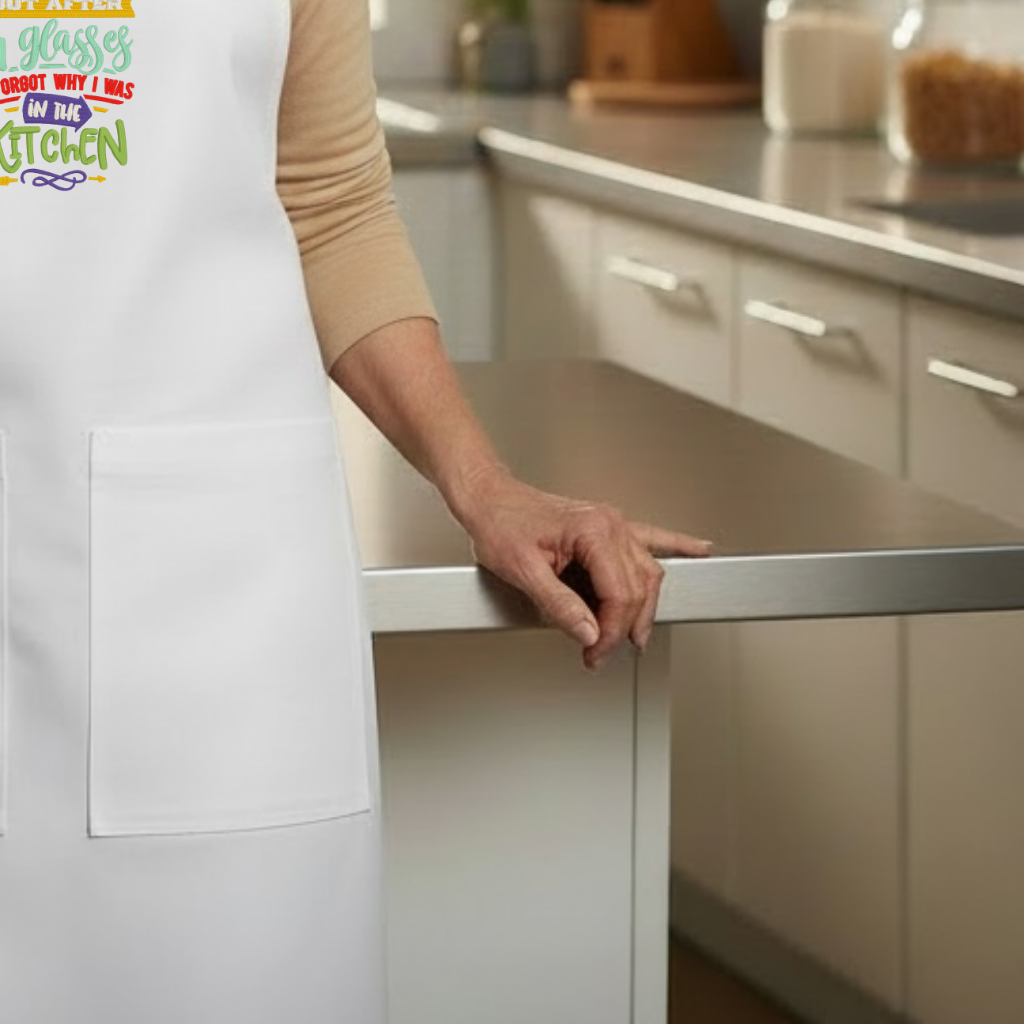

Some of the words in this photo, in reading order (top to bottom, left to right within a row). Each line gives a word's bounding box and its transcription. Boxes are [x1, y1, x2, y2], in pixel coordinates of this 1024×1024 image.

[18, 19, 134, 75] glasses
[53, 73, 87, 91] WHY
[92, 76, 98, 92] I
[104, 77, 135, 100] WAS
